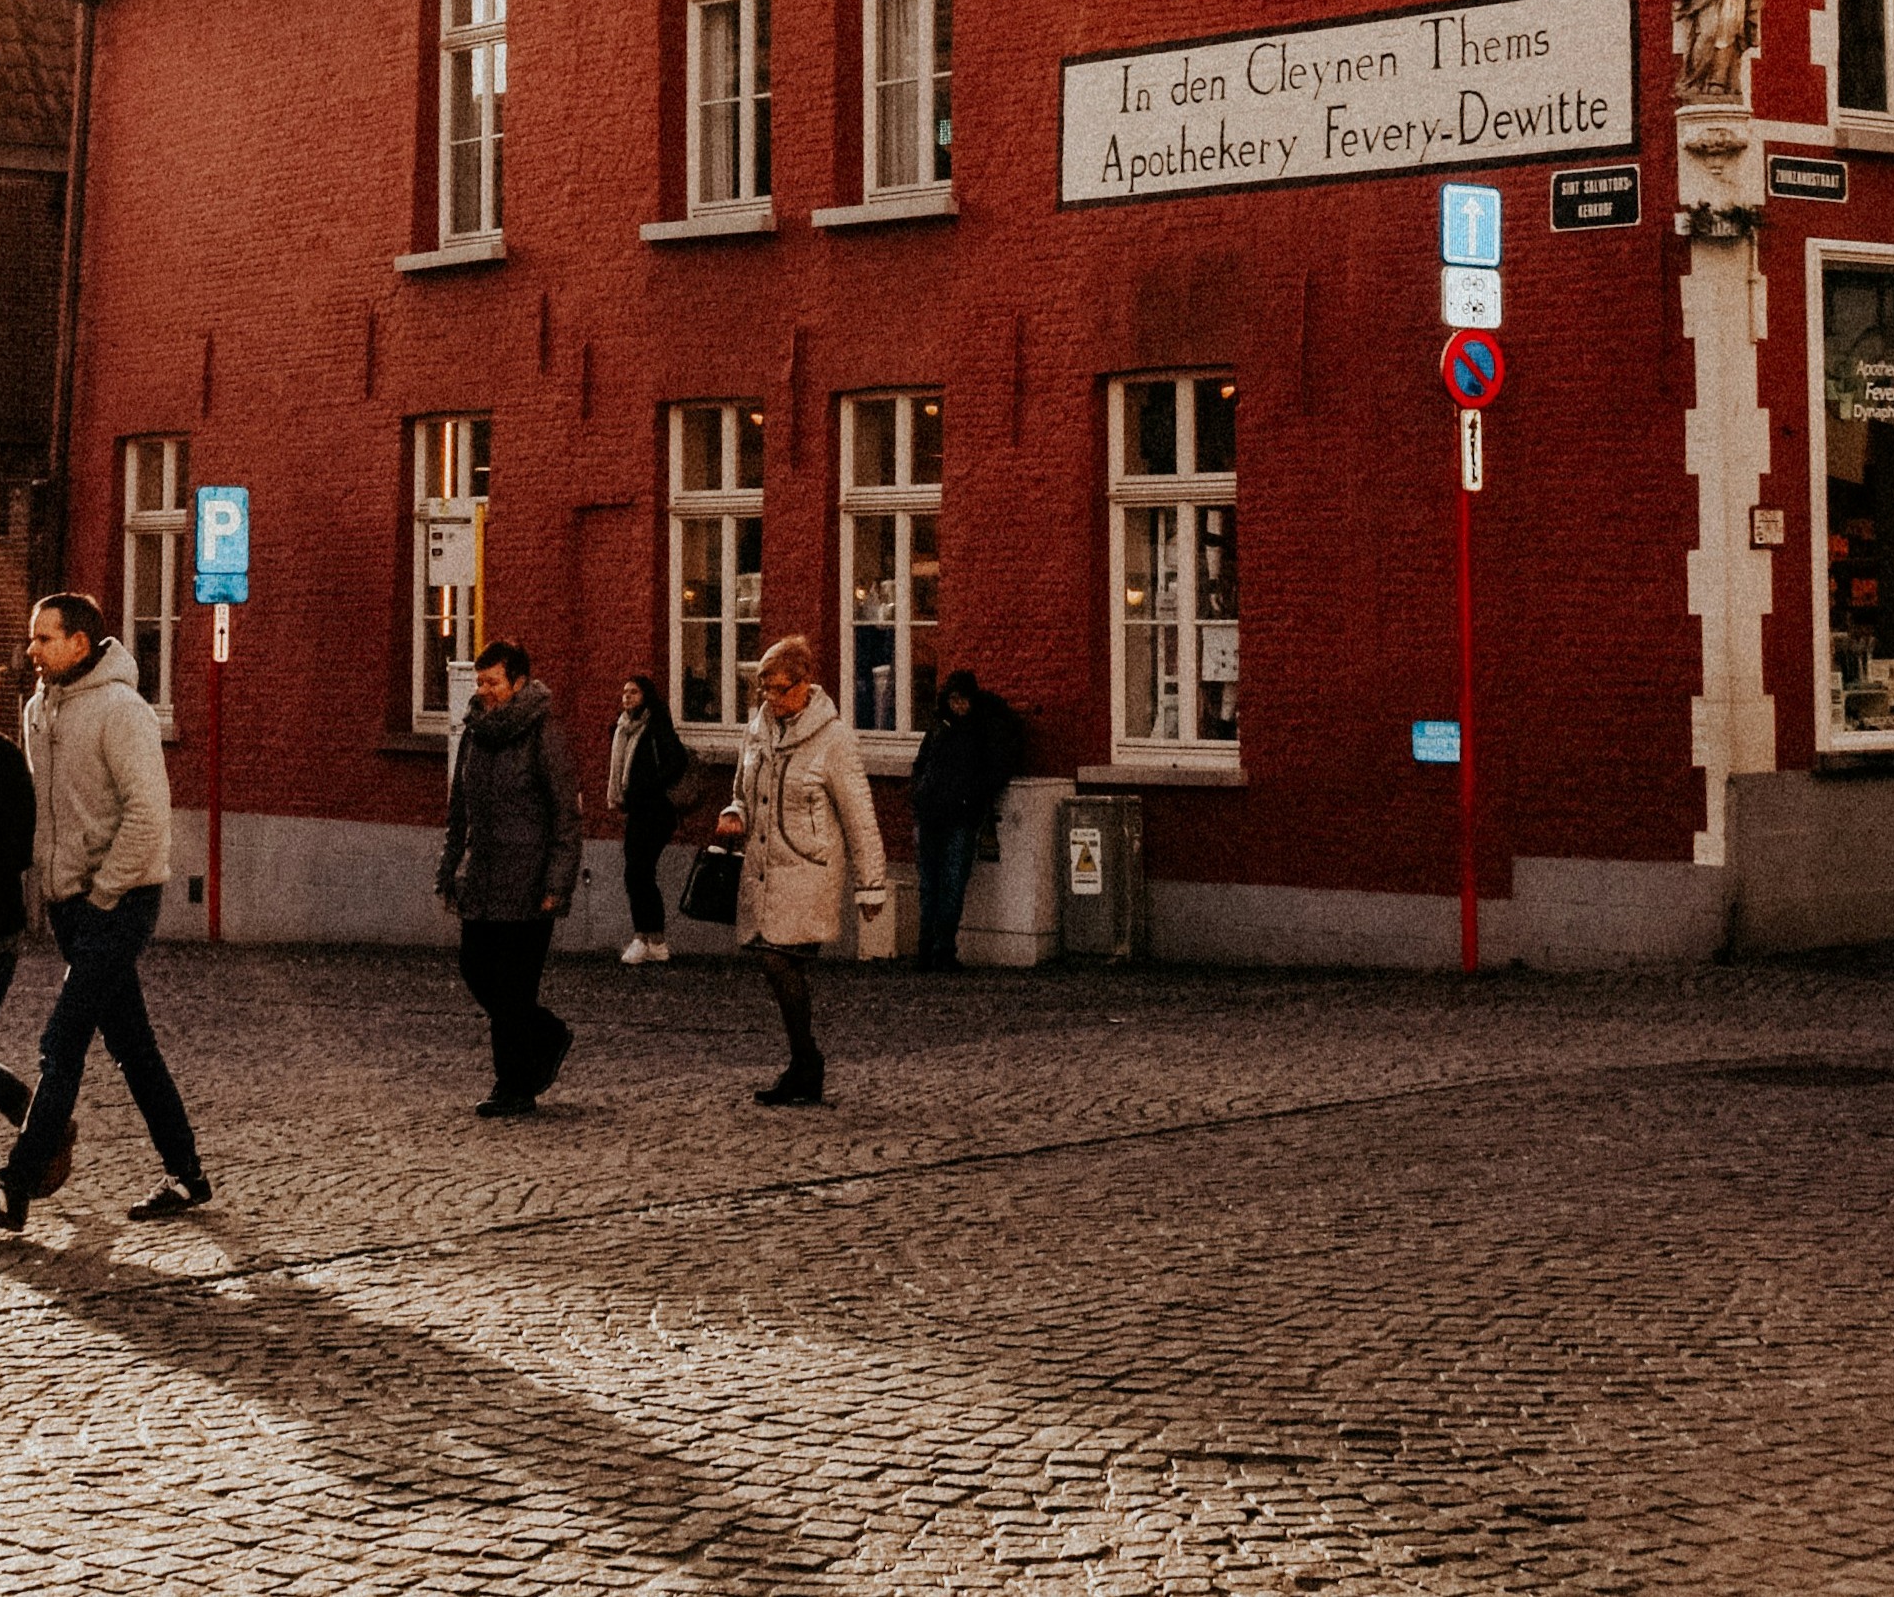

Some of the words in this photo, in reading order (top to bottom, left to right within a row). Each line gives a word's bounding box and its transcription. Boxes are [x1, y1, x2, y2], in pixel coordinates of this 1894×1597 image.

[1118, 64, 1151, 114] In
[1171, 58, 1226, 106] den
[1245, 42, 1398, 99] Cleynen
[1419, 14, 1550, 70] Thems
[1101, 119, 1298, 192] Apothekery
[1324, 89, 1609, 163] Fevery-Dewitte
[203, 500, 242, 561] P
